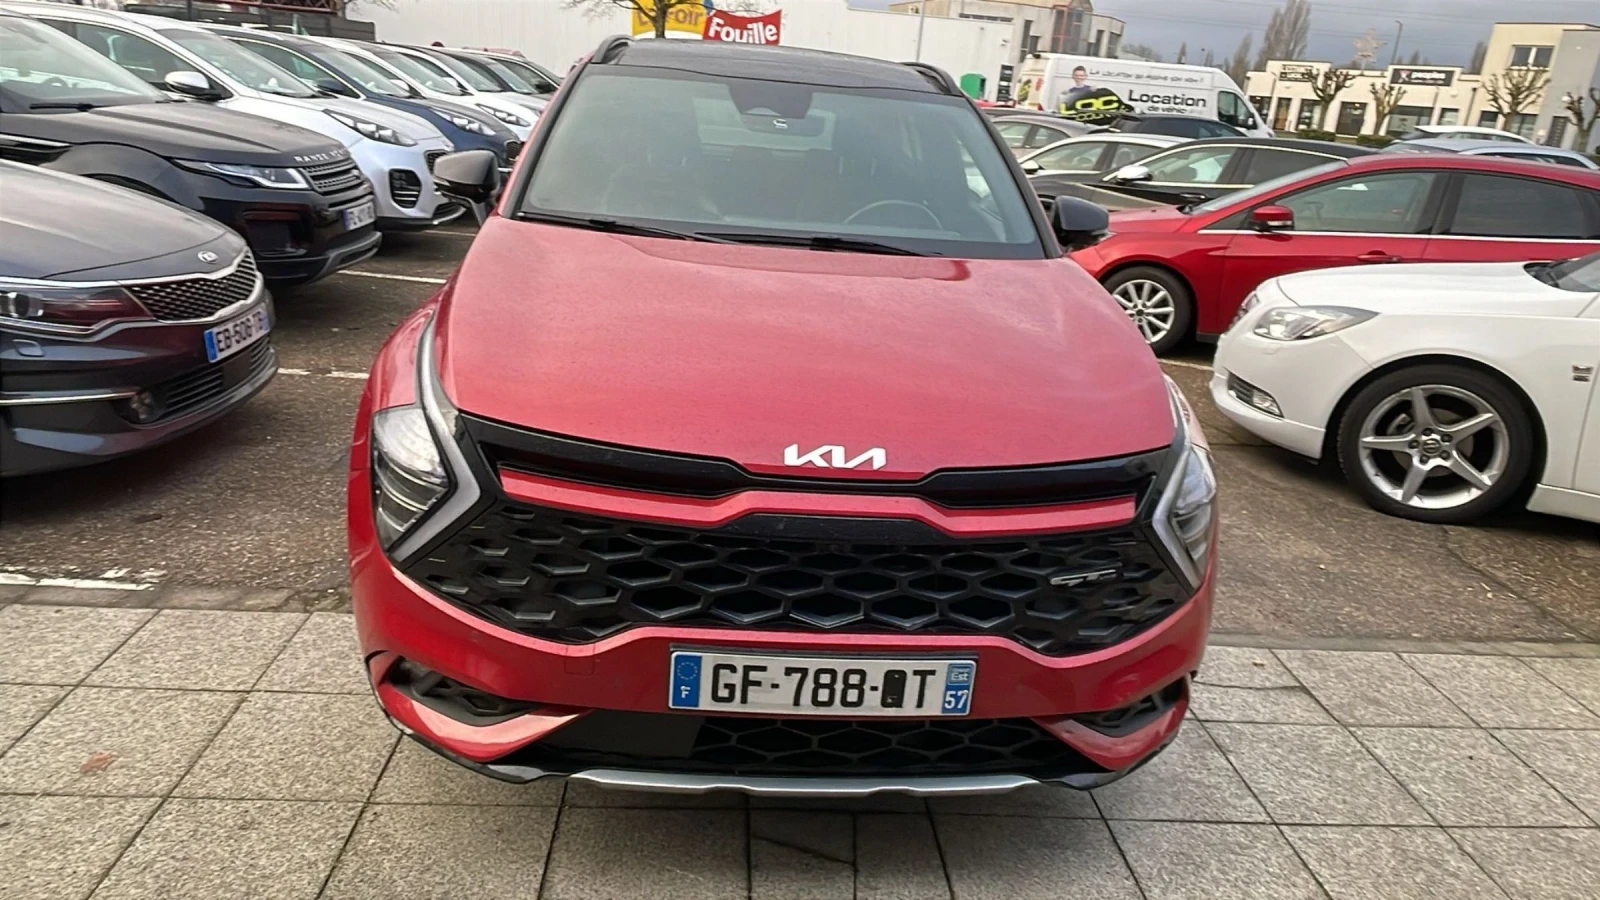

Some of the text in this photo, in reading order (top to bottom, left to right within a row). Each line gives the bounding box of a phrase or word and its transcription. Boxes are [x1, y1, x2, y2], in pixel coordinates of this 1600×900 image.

[708, 17, 778, 44] Fouille
[1128, 89, 1207, 108] Location
[783, 443, 887, 470] KIA
[680, 686, 691, 699] F
[944, 690, 969, 709] 57
